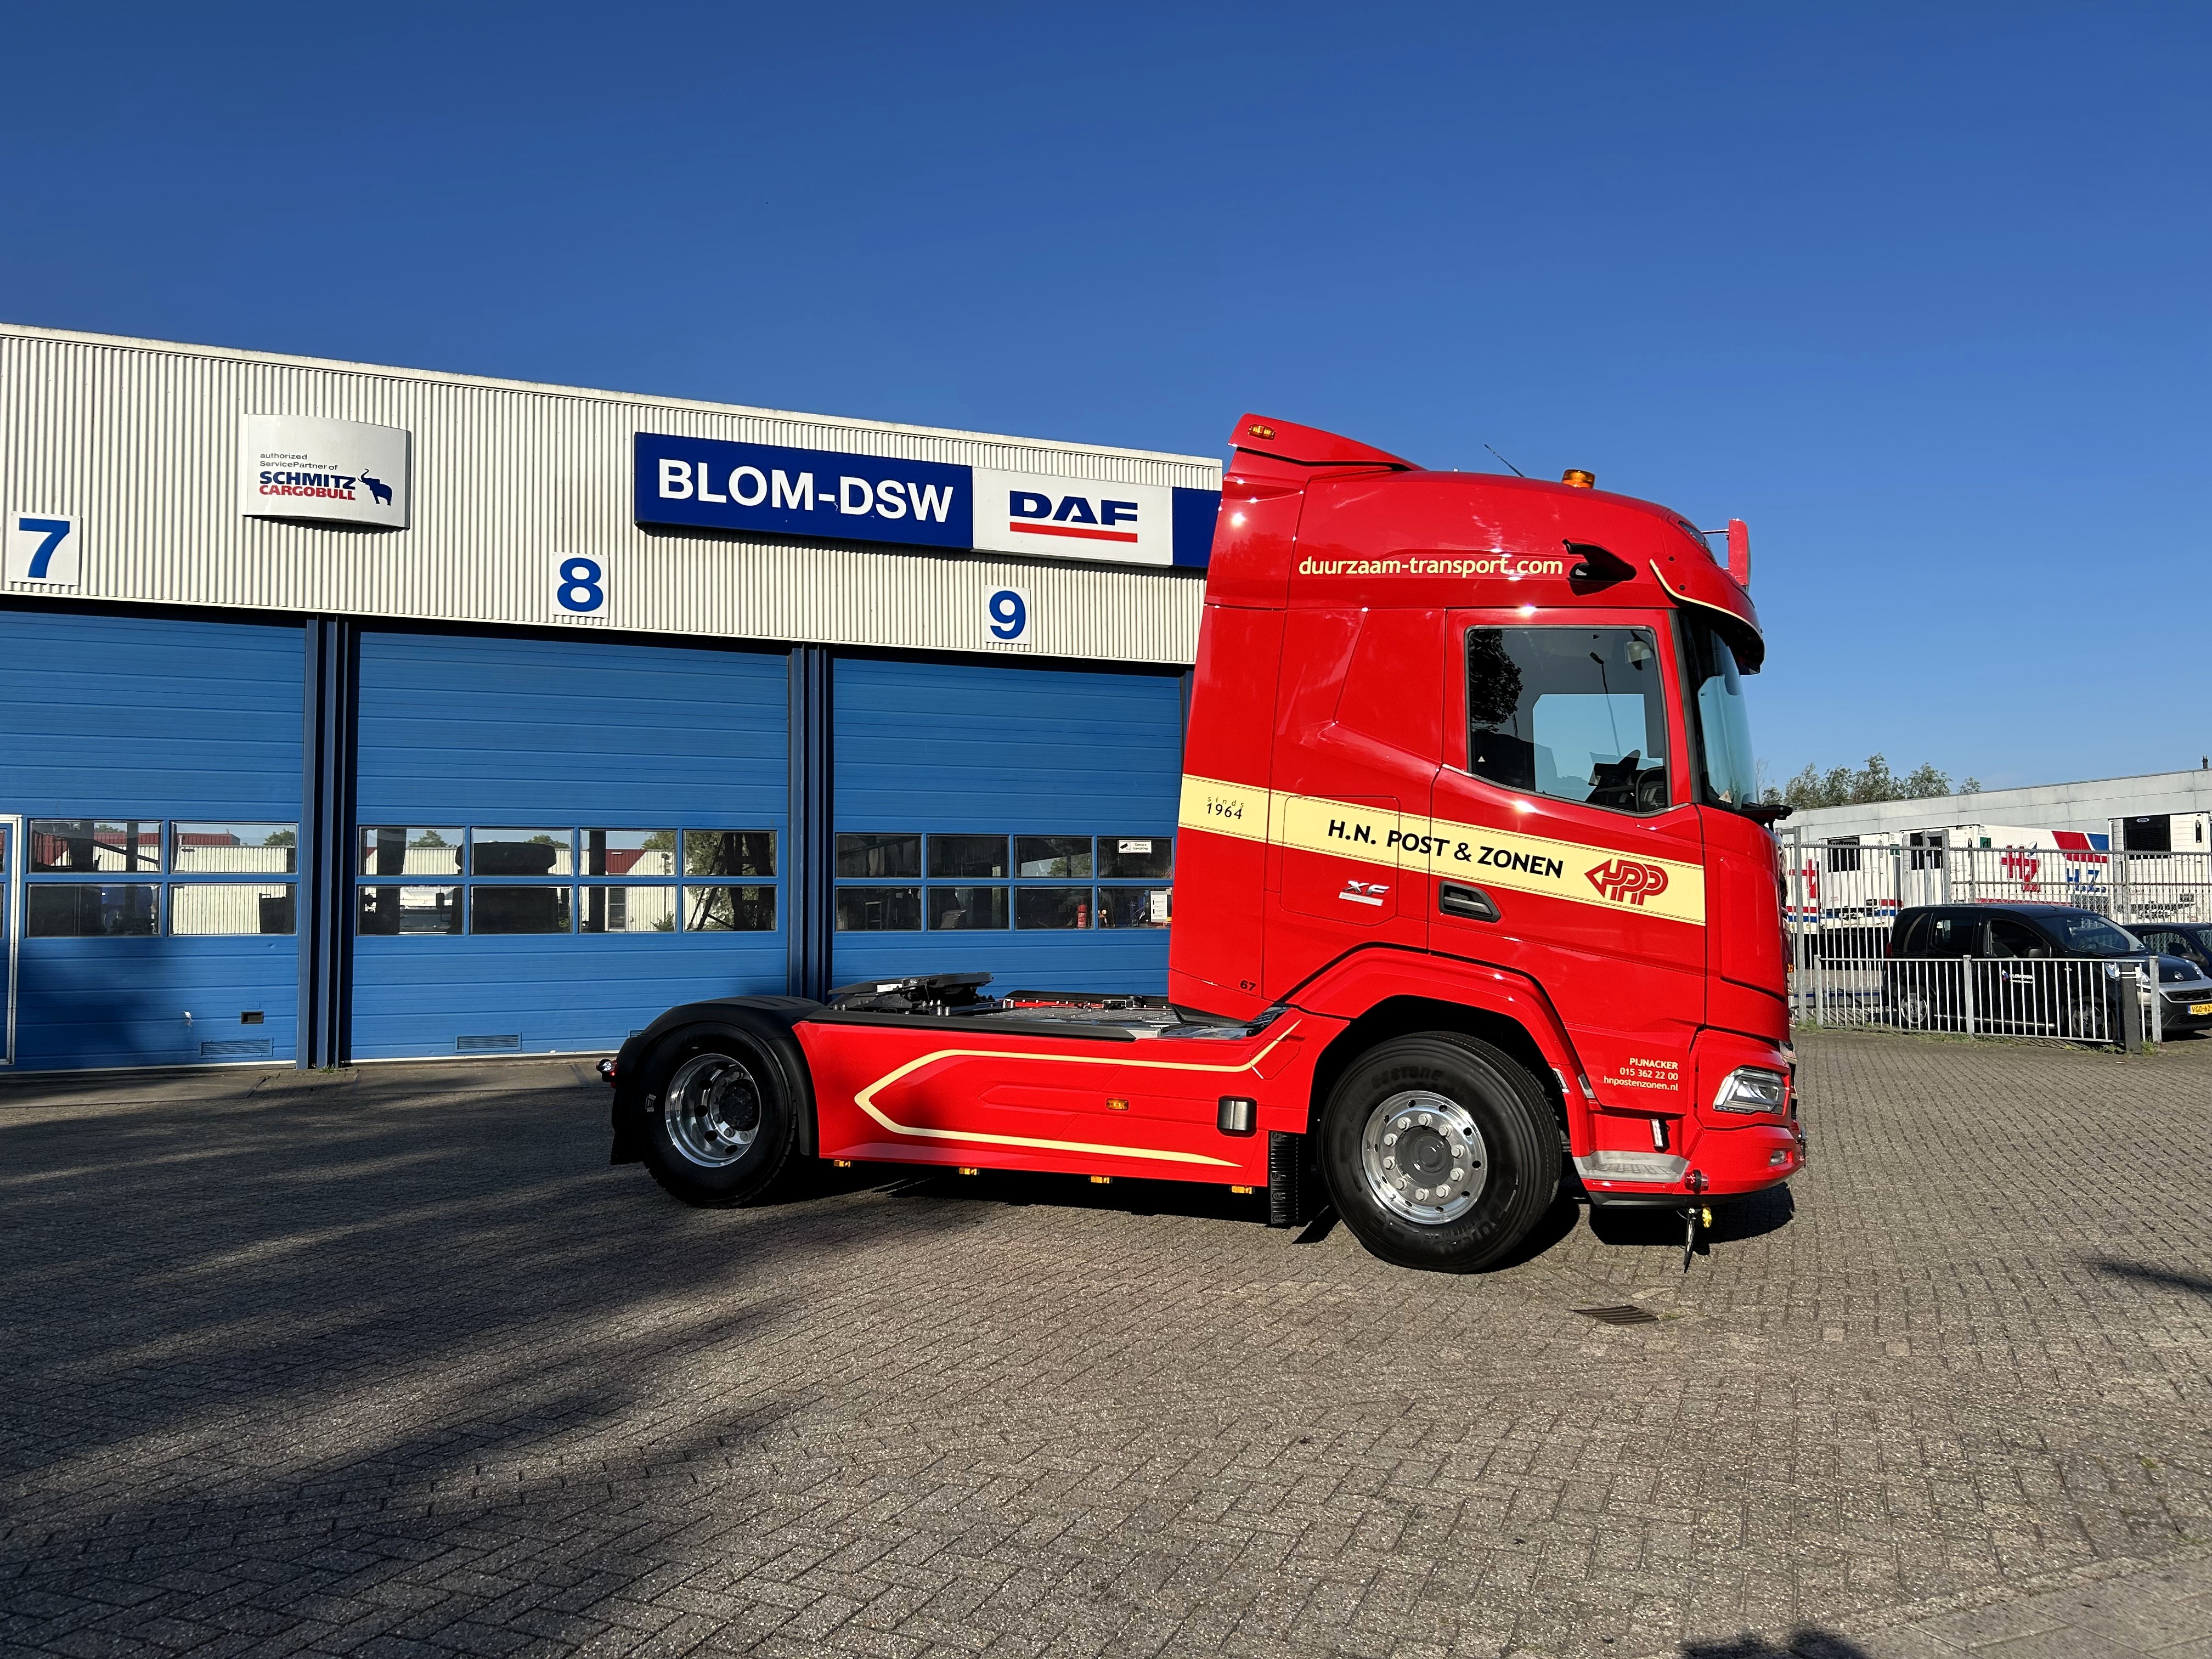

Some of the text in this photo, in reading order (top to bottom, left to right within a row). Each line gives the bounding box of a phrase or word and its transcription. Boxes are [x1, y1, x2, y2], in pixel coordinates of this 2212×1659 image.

[259, 460, 328, 469] ServicePartner
[259, 471, 356, 490] SCHMITZ
[259, 485, 356, 501] CARGOBULL
[659, 459, 953, 523] BLOM-DSW
[1009, 490, 1138, 526] DAF
[19, 517, 70, 579] 7
[1299, 556, 1563, 578] duurzaam-transport.com
[557, 557, 604, 612] 8
[989, 590, 1026, 640] 9
[1206, 802, 1242, 820] 1964
[1207, 796, 1244, 808] sinds
[1328, 819, 1564, 879] H.N. POST & ZONEN
[1342, 880, 1390, 895] XF
[1240, 979, 1256, 992] 67
[1629, 1057, 1679, 1070] PIJNACKER
[1603, 1075, 1679, 1091] hnpostenzonen.nl
[1620, 1067, 1679, 1081] 015 362 22 00
